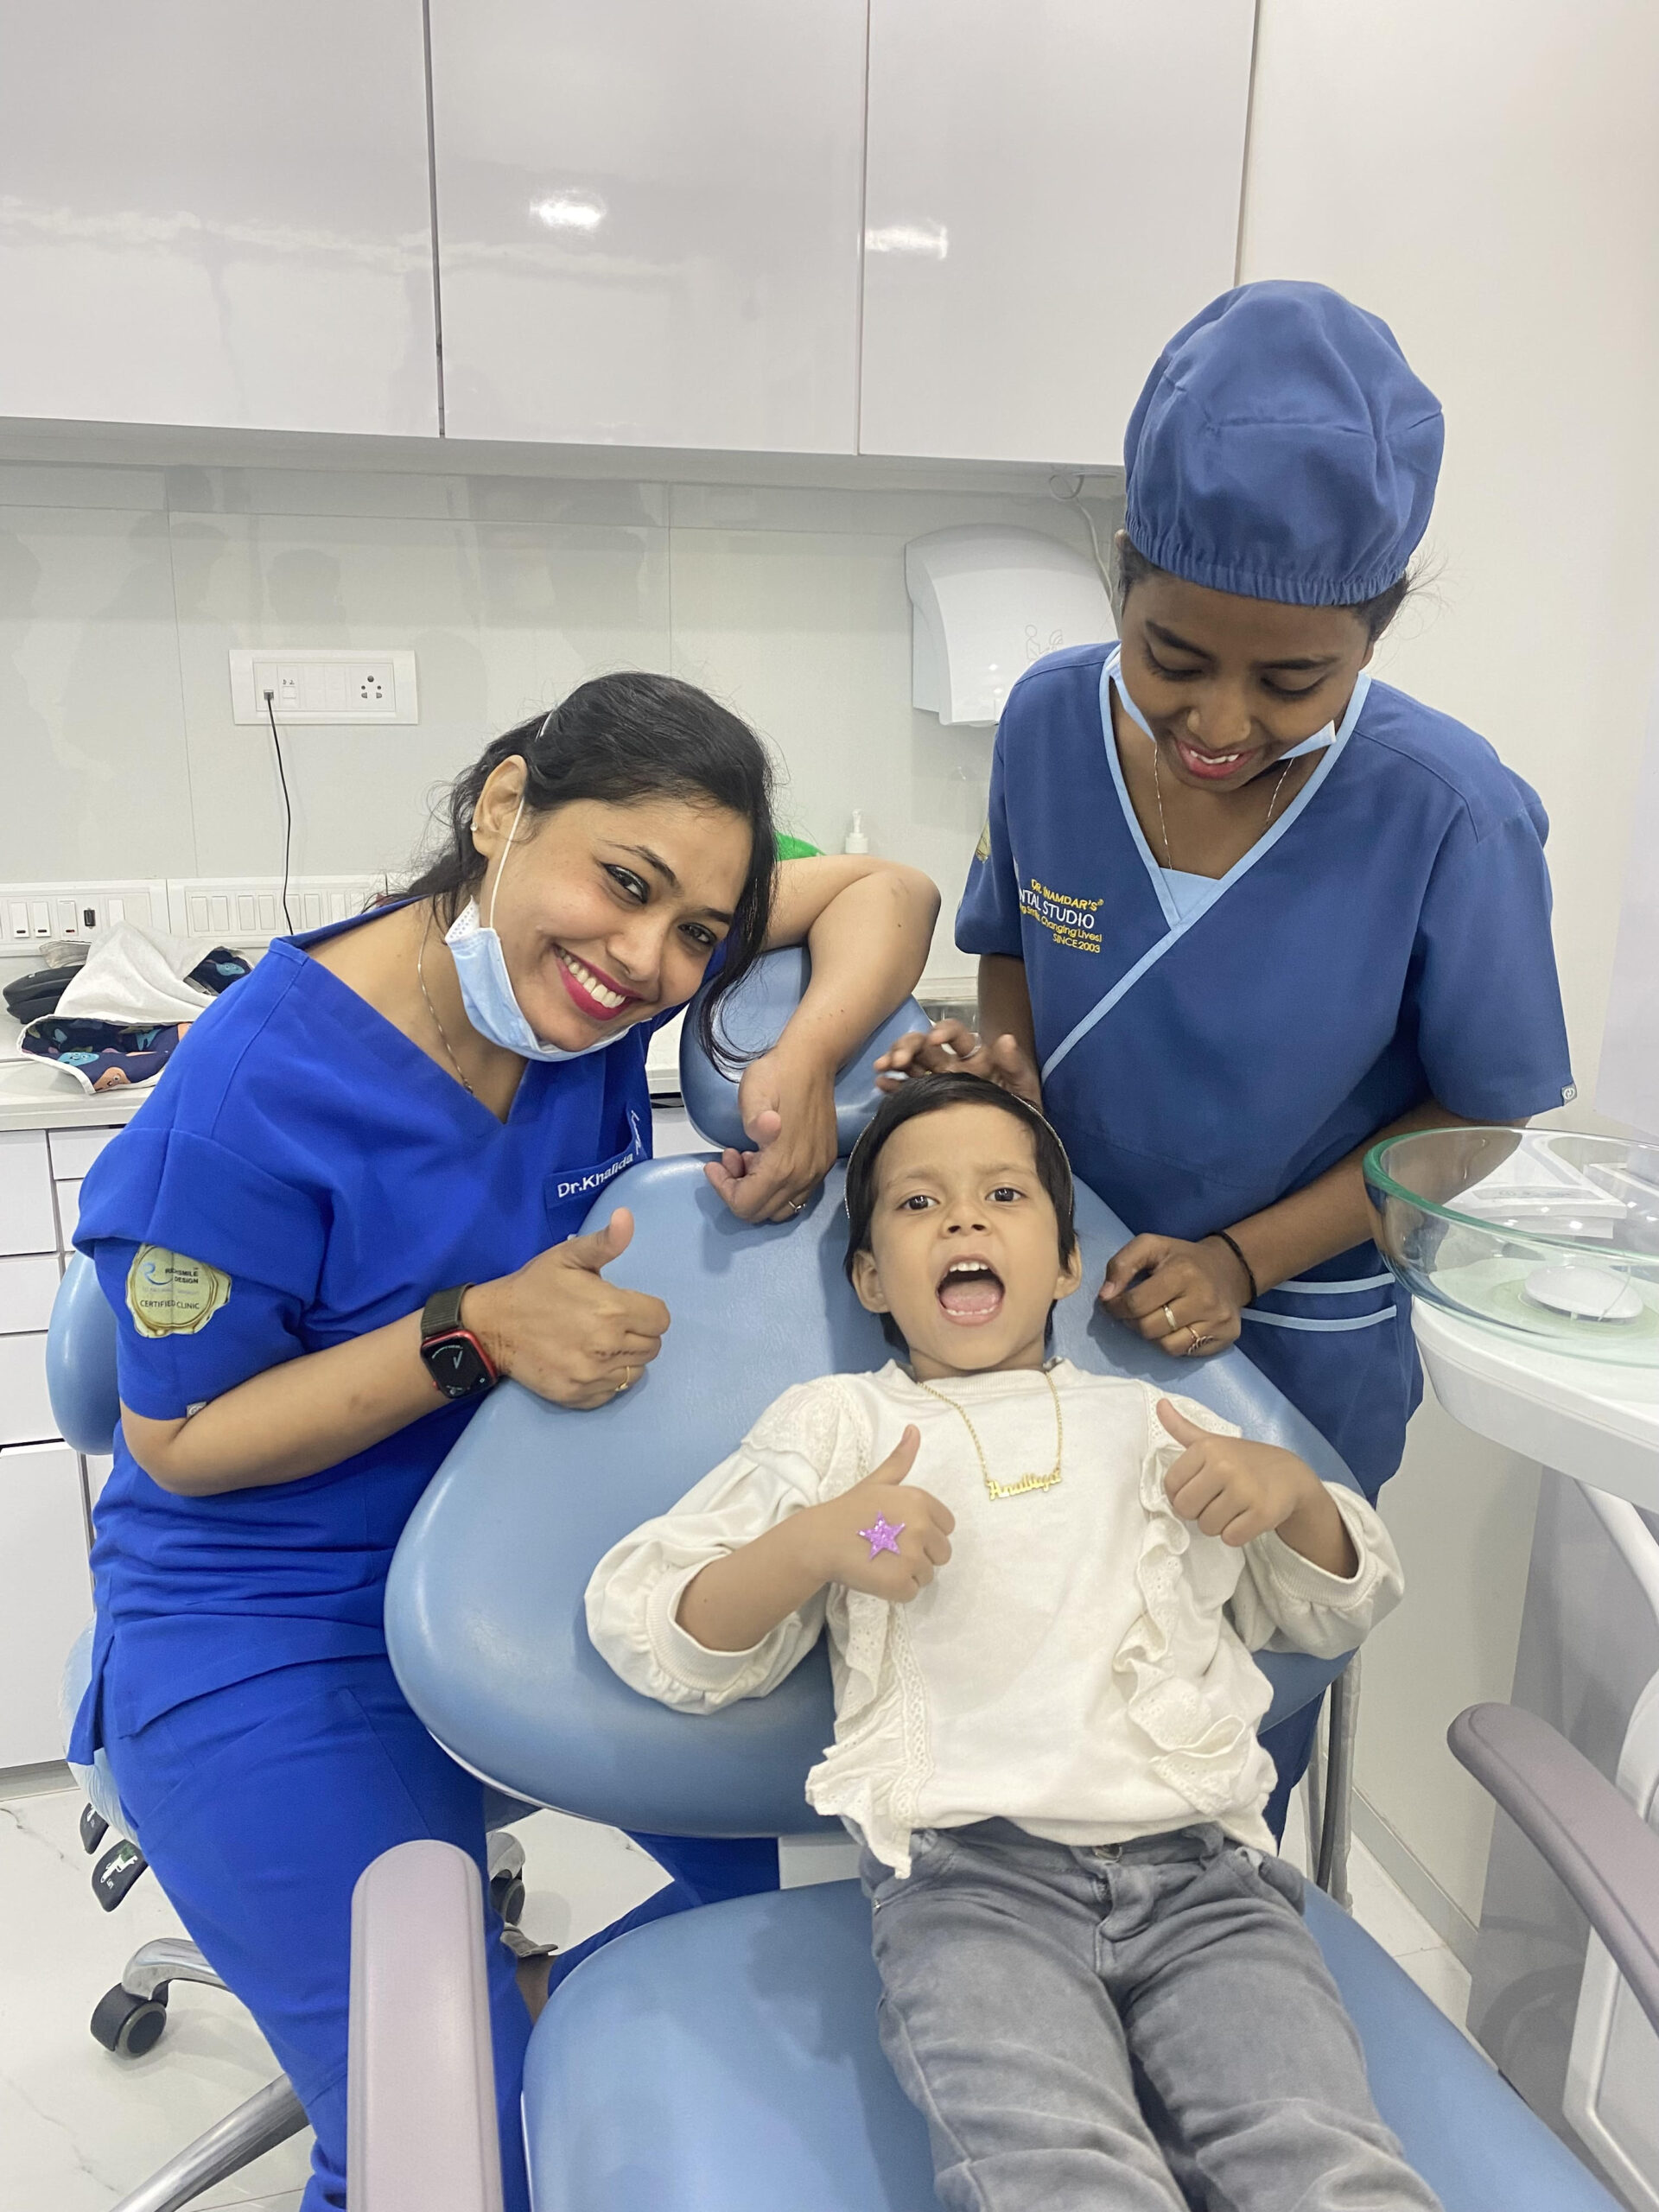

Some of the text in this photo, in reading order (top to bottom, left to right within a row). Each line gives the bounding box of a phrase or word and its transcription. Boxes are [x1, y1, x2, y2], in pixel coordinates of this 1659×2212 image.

[1042, 900, 1095, 929] STUDIO
[1041, 916, 1077, 938] Changing
[1052, 933, 1101, 953] SINCE 2003
[140, 1300, 175, 1308] CERTIFIED
